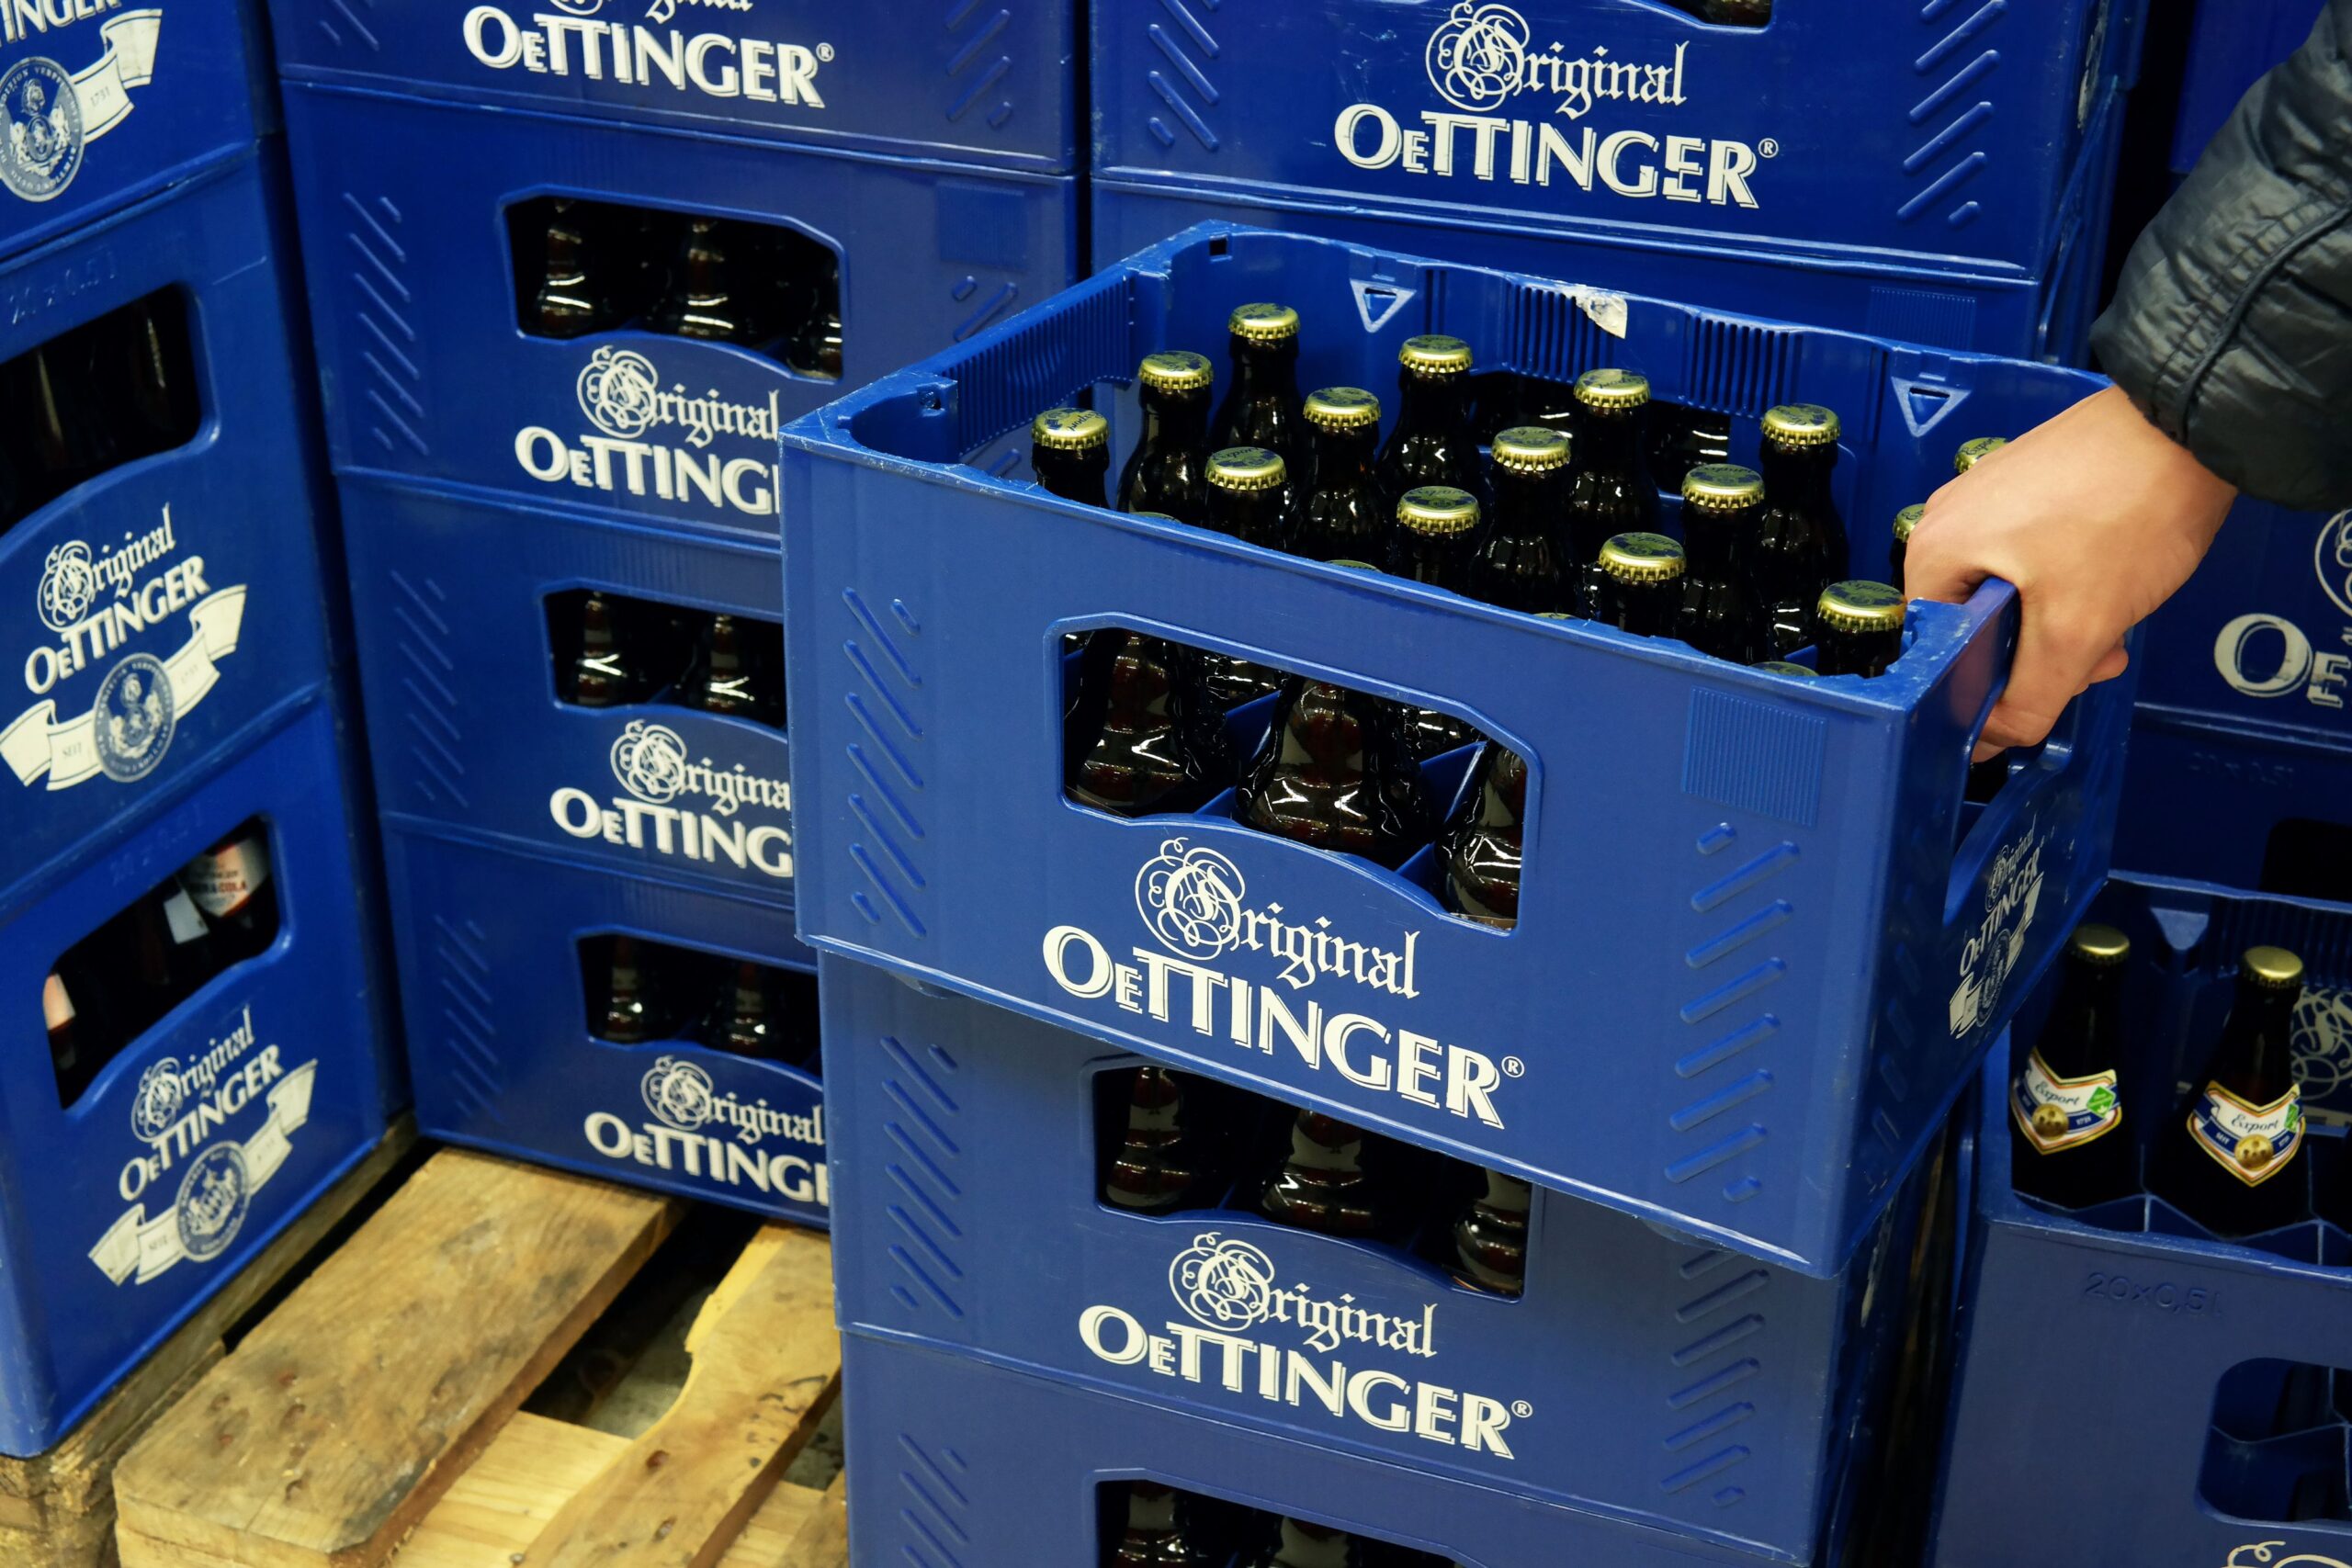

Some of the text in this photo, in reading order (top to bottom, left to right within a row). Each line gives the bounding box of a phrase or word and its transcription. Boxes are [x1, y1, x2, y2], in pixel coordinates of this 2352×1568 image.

[1425, 1, 1690, 120] Original
[577, 345, 779, 449] Original
[514, 426, 780, 516] OETTING
[37, 502, 176, 633] Original
[25, 556, 211, 695] OETTINGER
[610, 719, 792, 817] Origina
[549, 787, 794, 878] OETTING
[1135, 838, 1421, 999] Original
[119, 1044, 284, 1202] OETTINGER
[131, 1004, 255, 1143] Original
[640, 1055, 826, 1145] Original
[2035, 1081, 2080, 1105] Export
[2231, 1112, 2279, 1133] Export
[1169, 1232, 1439, 1359] Original
